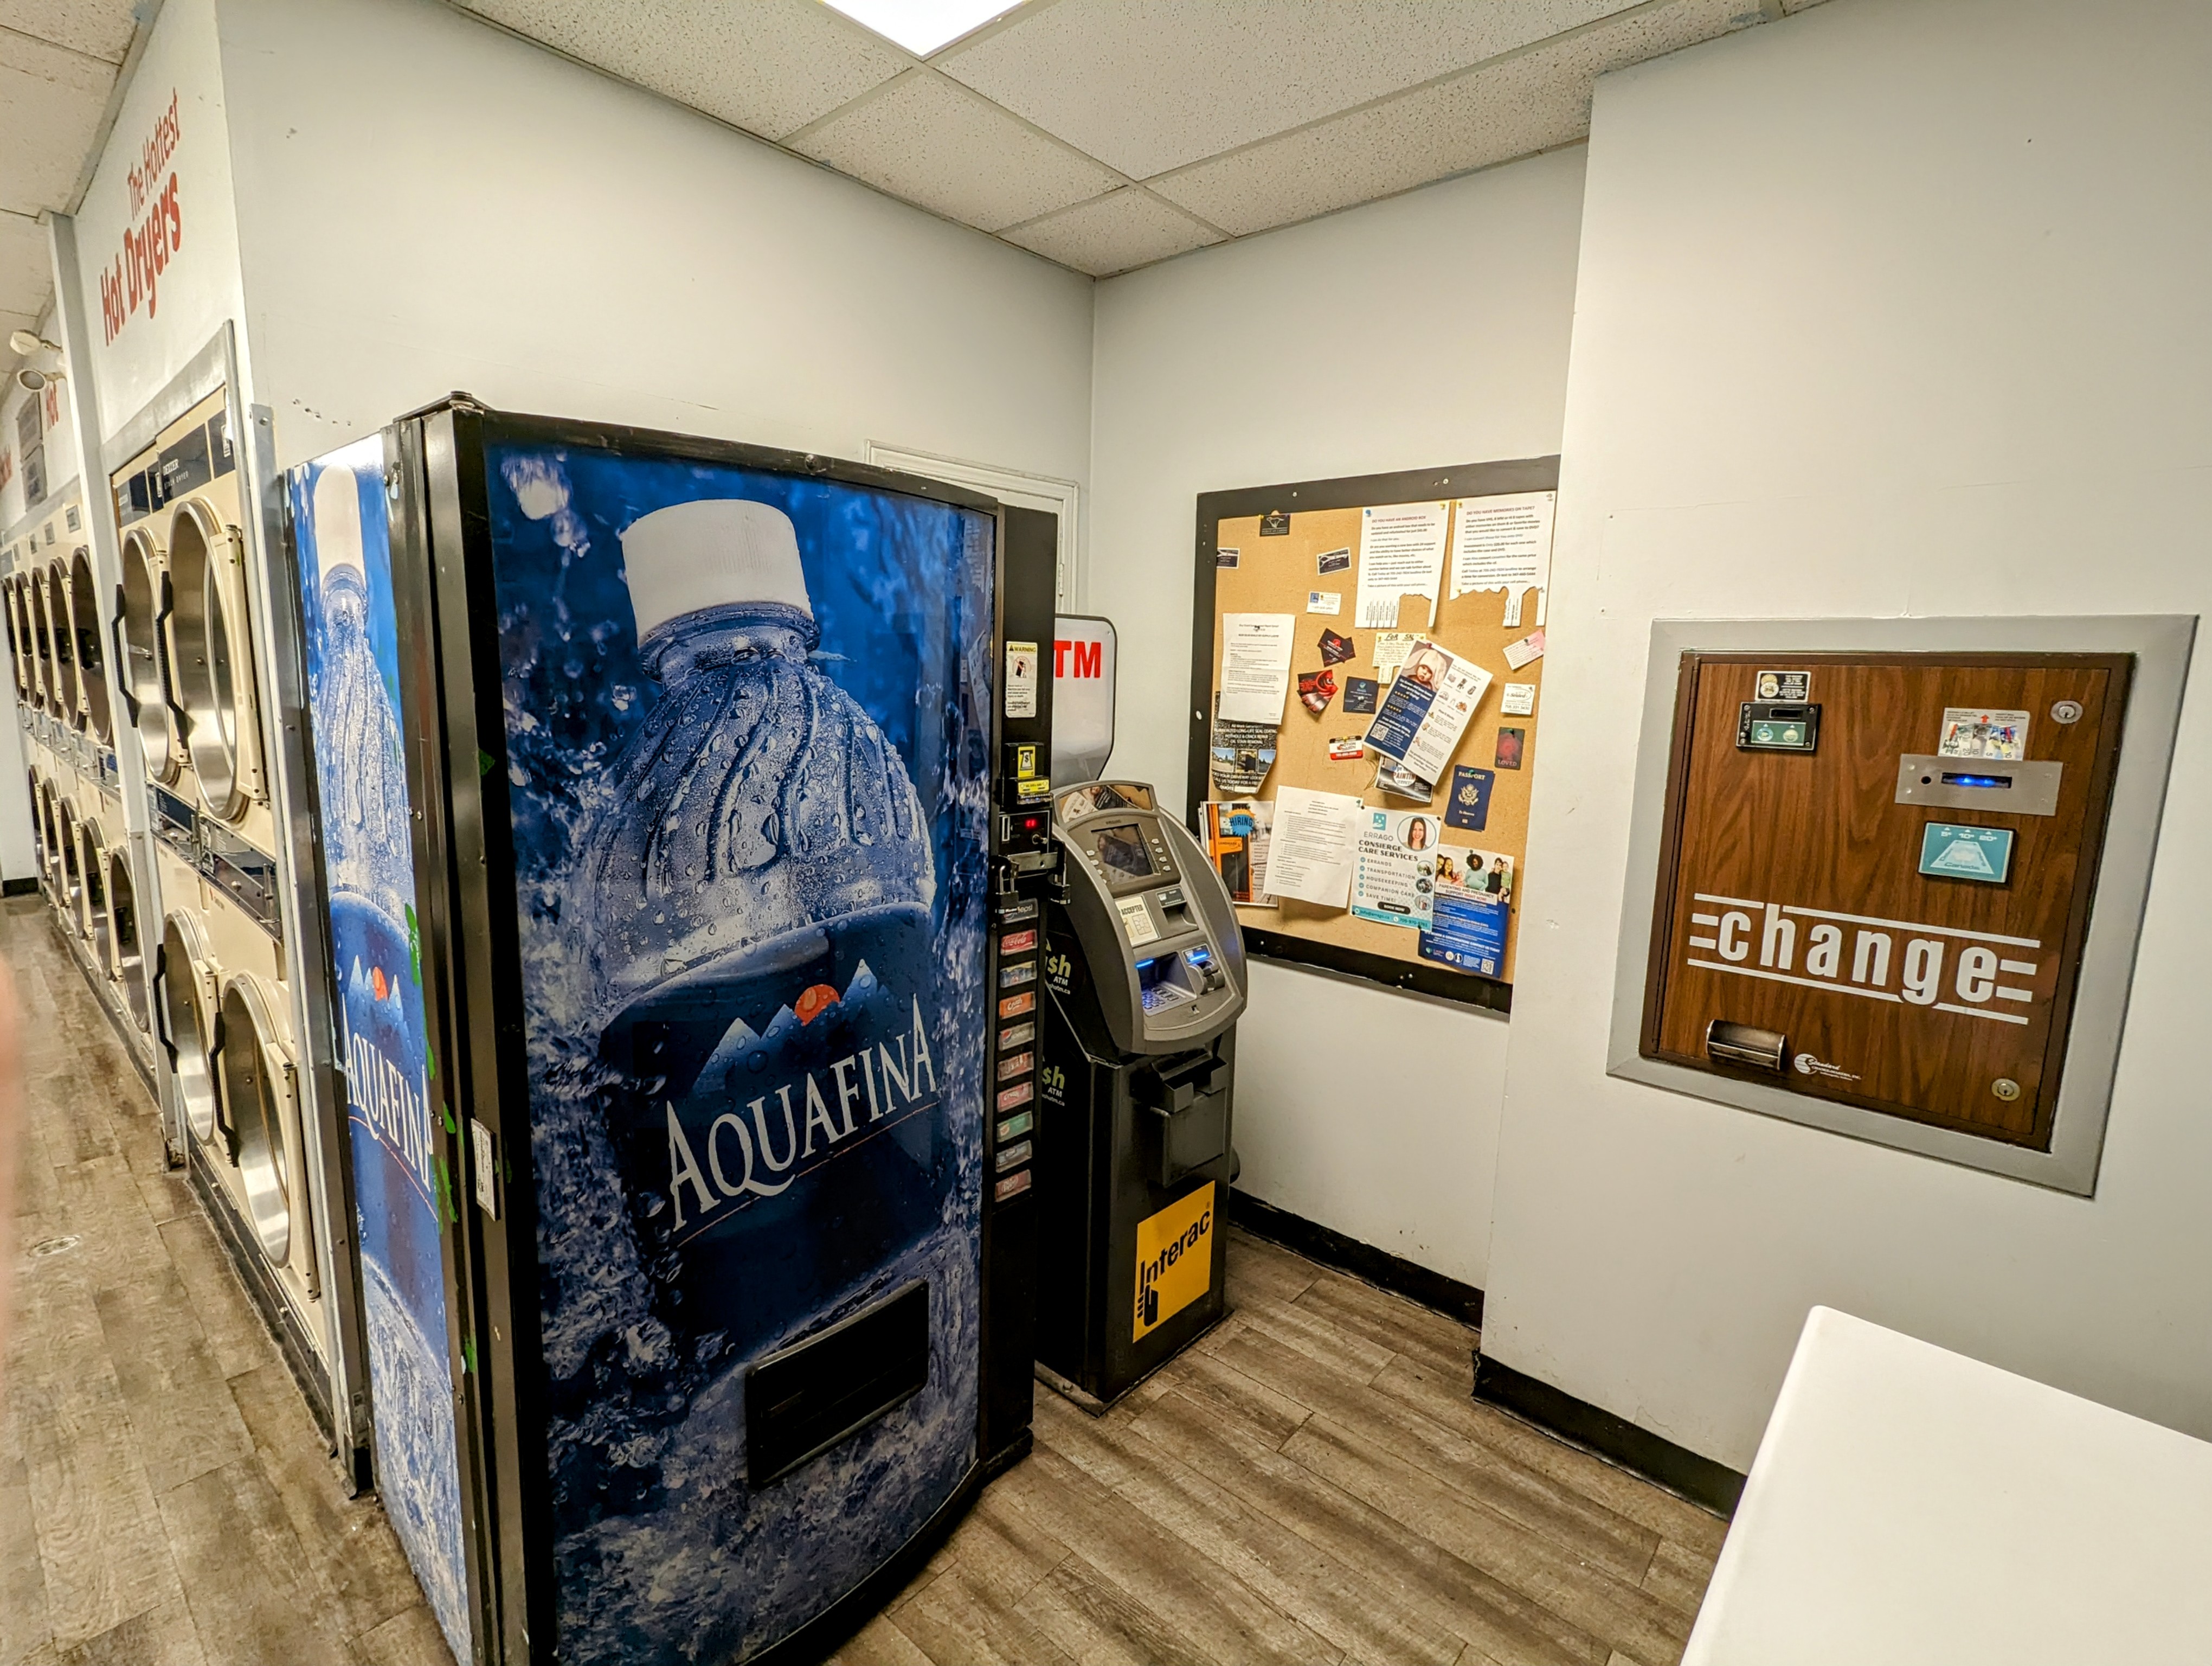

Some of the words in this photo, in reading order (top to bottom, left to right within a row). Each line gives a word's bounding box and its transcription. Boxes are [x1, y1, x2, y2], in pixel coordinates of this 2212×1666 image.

[128, 162, 144, 221] The
[143, 86, 179, 194] Hottest
[101, 253, 125, 346] Hot
[124, 172, 181, 318] Dryers
[1230, 816, 1253, 826] HIRING
[1364, 831, 1393, 842] ERRAGO
[1359, 840, 1403, 851] CONSIERGE
[1358, 847, 1379, 855] CARE
[1380, 850, 1418, 862] SERVICES
[1367, 858, 1392, 867] ERRANDS
[1367, 867, 1416, 880] TRANSPORTATION
[1366, 876, 1408, 887] HOUSEKEEPING
[1366, 885, 1399, 894] COMPANION
[1439, 883, 1462, 892] PARENTING
[1471, 889, 1494, 899] PREGNANCY
[1121, 905, 1143, 915] ACCEPTED
[1718, 903, 1998, 1005] change
[1053, 976, 1068, 986] ATM
[342, 992, 433, 1193] AQUAFINA
[1047, 1087, 1063, 1097] ATM
[667, 994, 937, 1232] AQUAFINA
[1140, 1210, 1210, 1296] Interac
